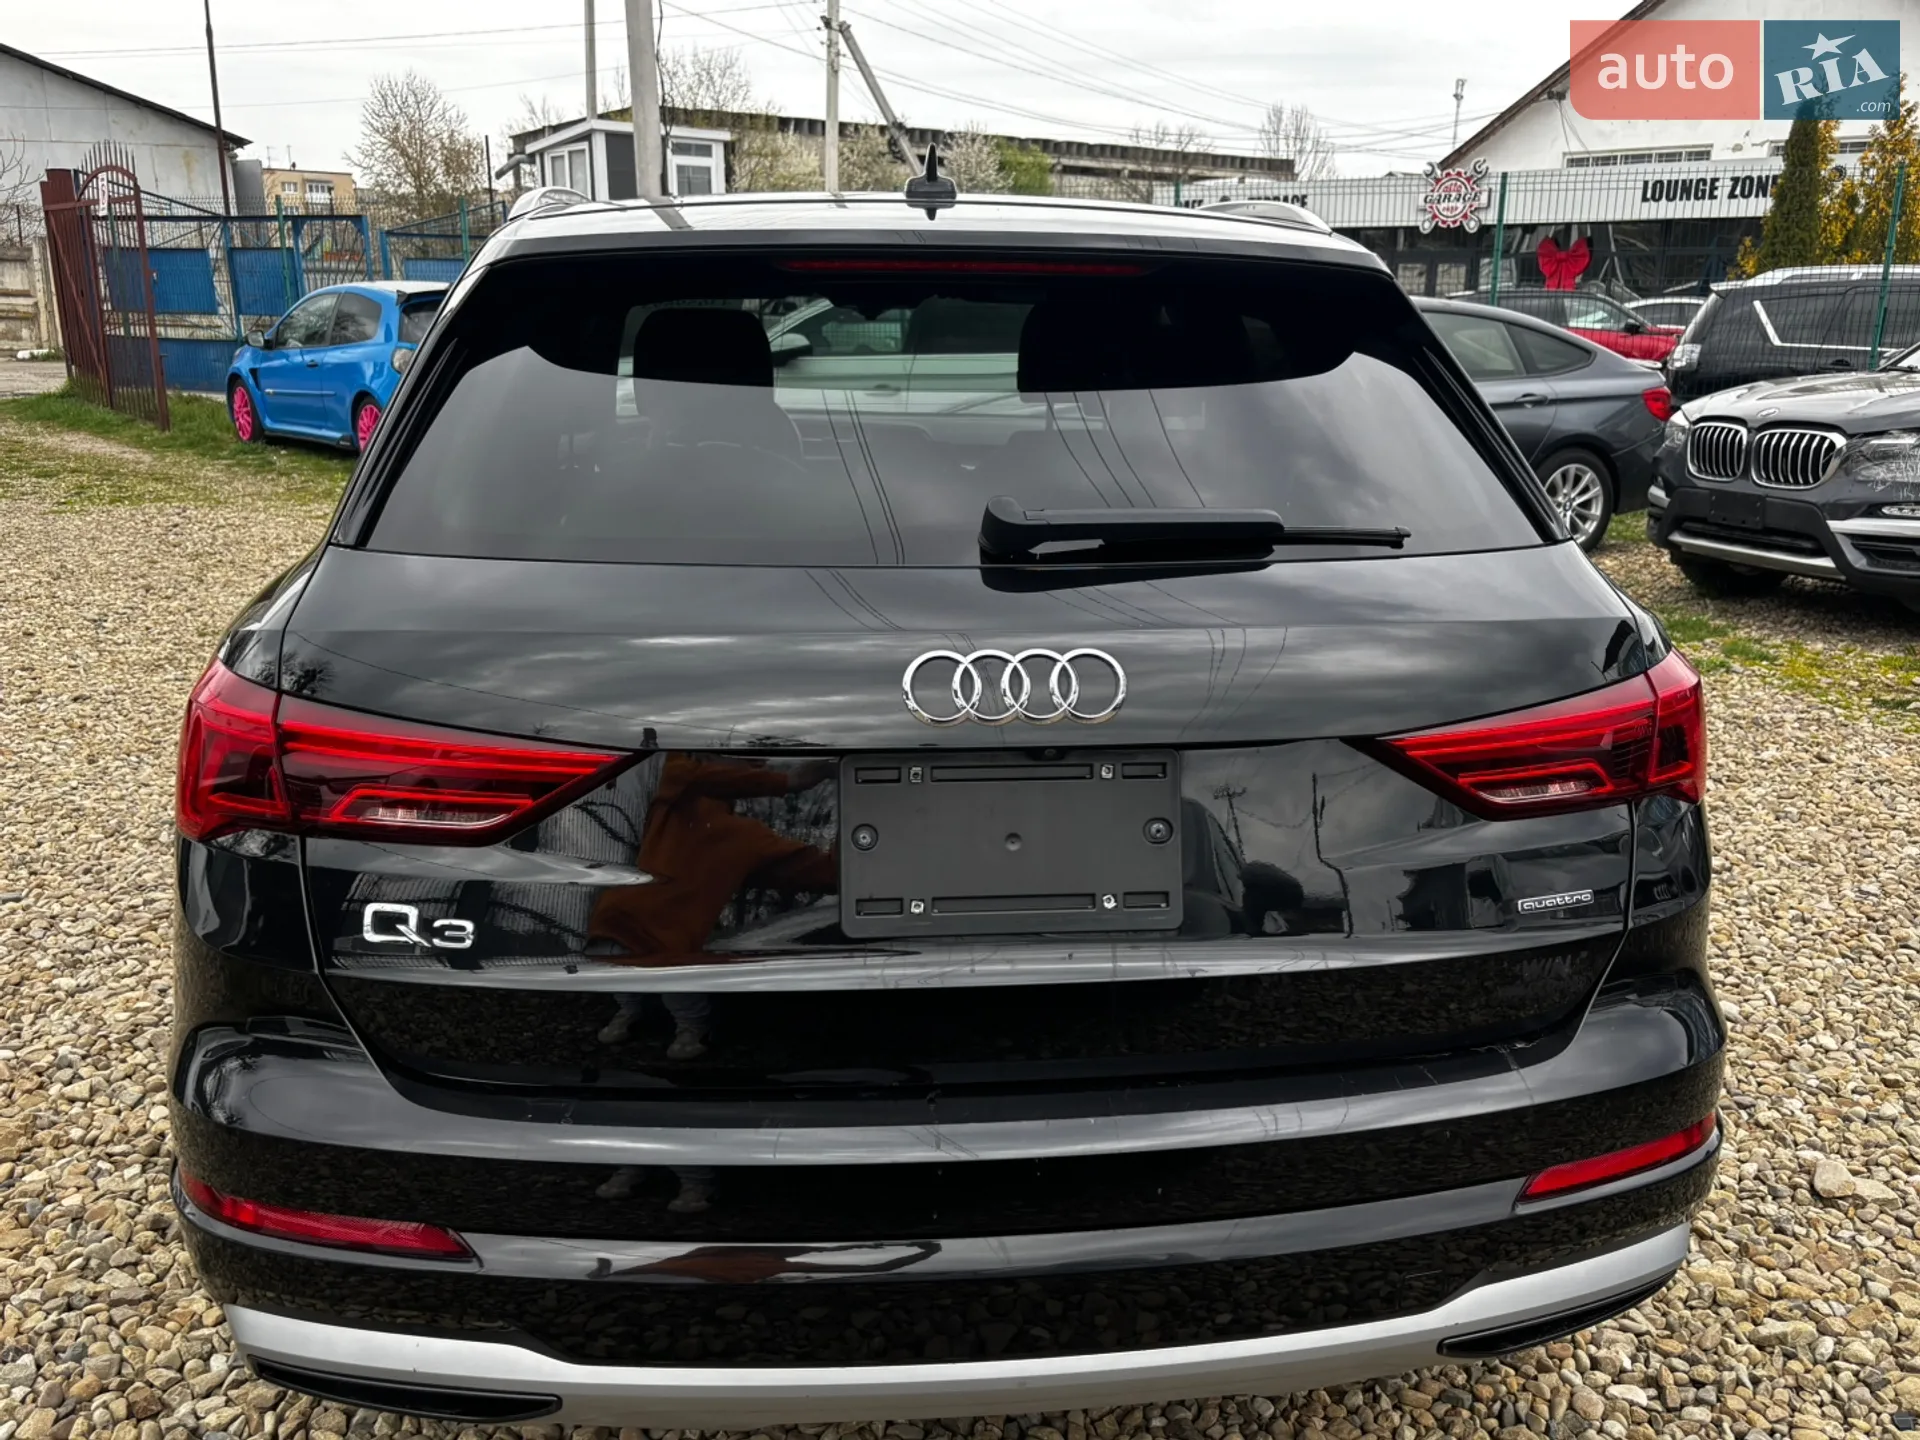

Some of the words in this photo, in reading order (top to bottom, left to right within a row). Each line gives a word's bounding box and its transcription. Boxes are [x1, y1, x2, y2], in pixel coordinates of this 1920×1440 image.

[1424, 191, 1482, 204] GARAGE
[1641, 177, 1720, 203] LOUNGE
[1523, 893, 1592, 911] quattro
[363, 902, 475, 949] Q3
